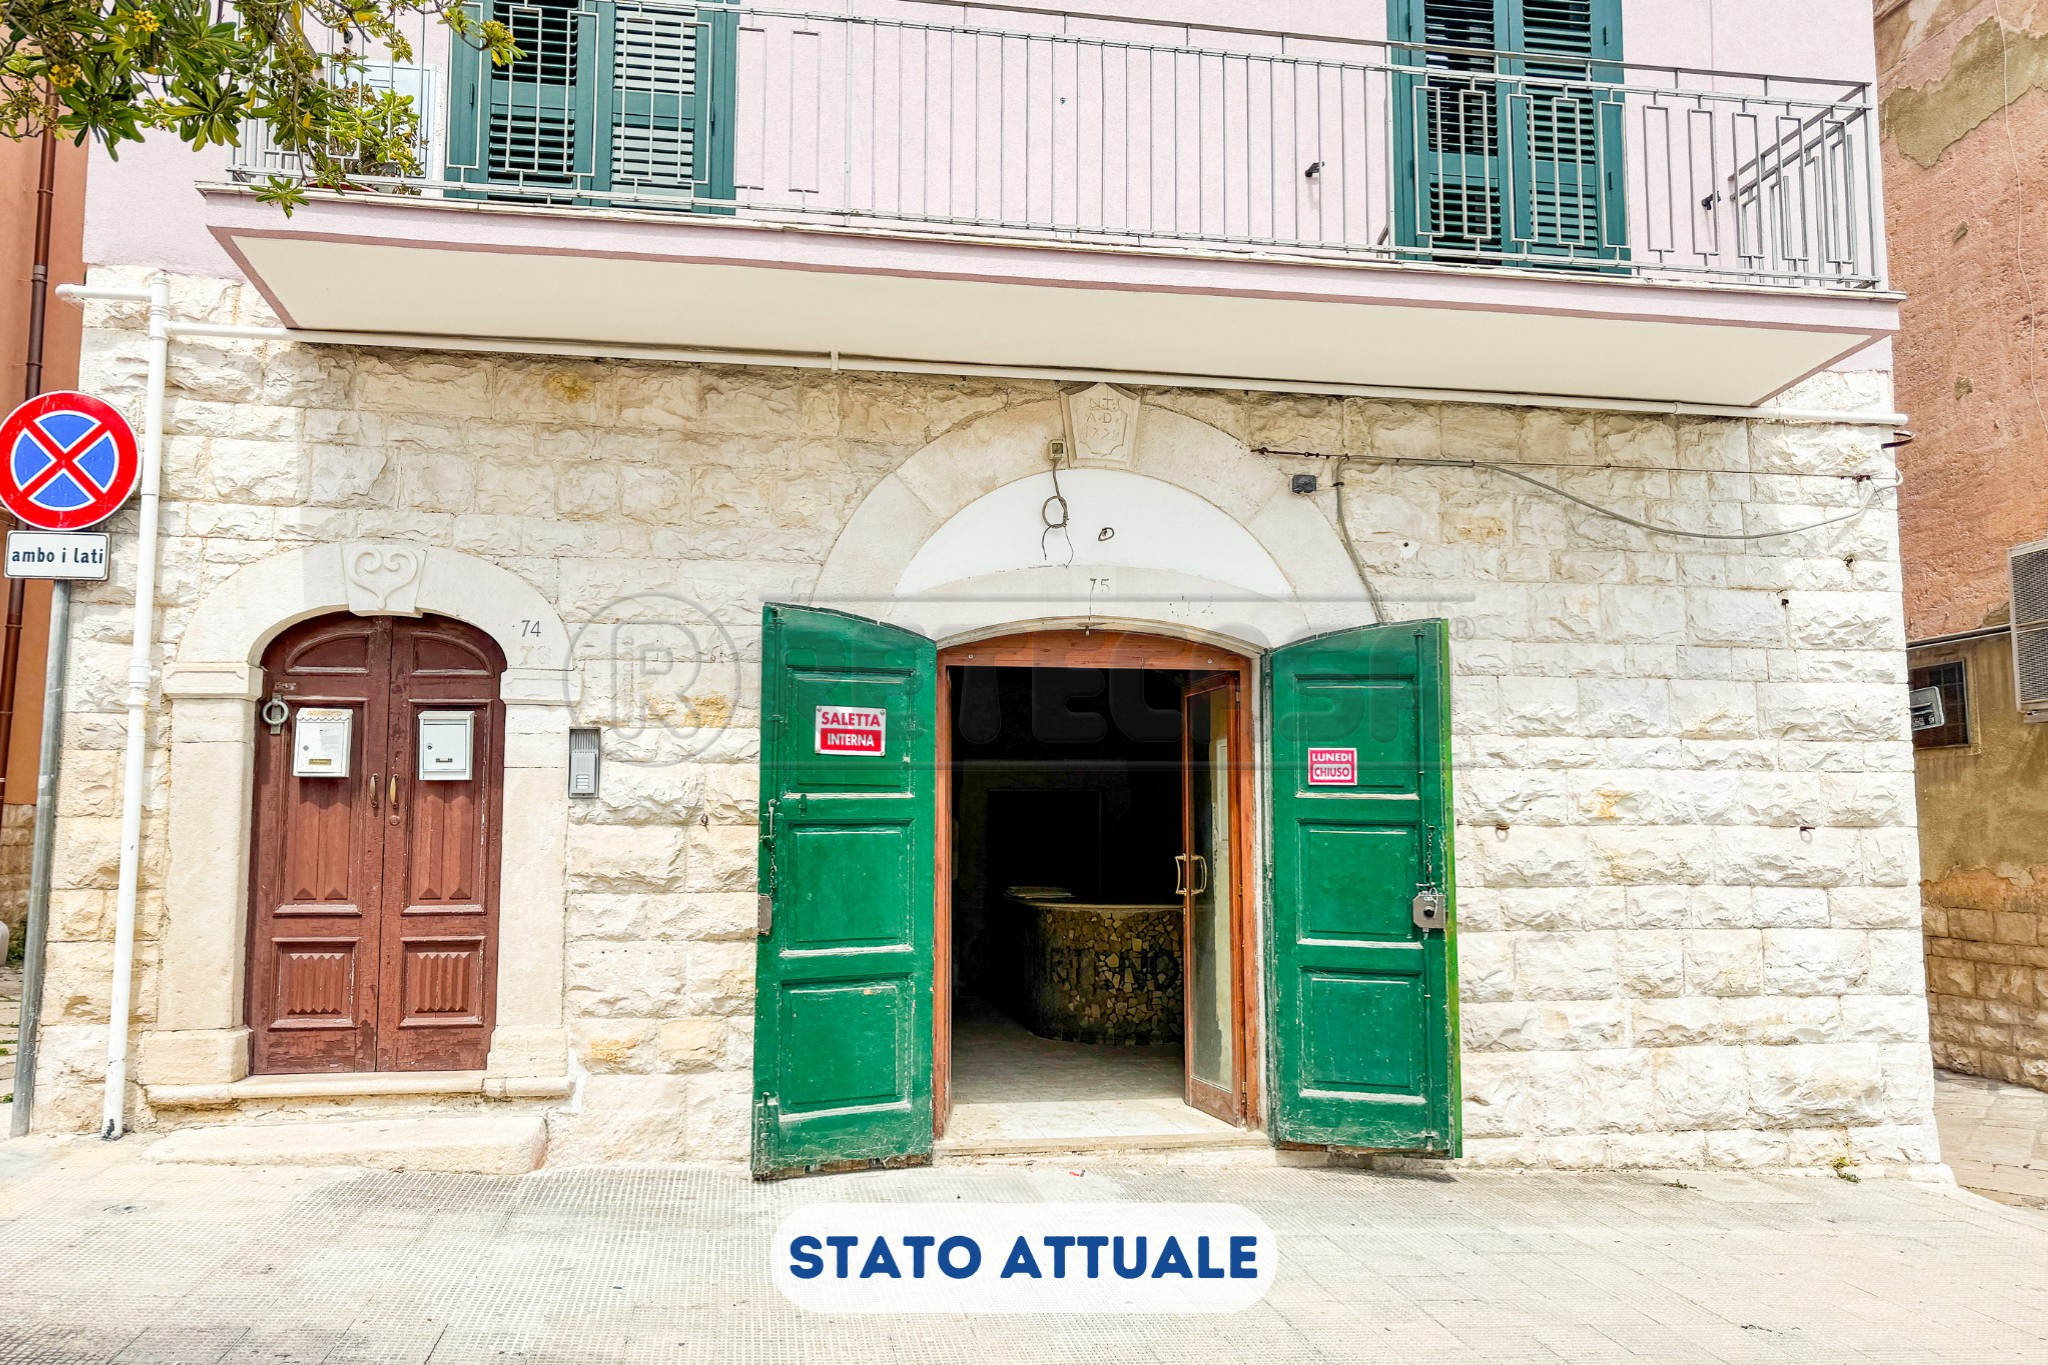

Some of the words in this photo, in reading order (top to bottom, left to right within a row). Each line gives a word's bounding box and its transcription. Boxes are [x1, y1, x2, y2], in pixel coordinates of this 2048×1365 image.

[12, 546, 55, 563] ambo
[61, 547, 67, 563] i
[73, 547, 104, 564] lati
[1089, 577, 1111, 593] 75
[521, 619, 542, 638] 74
[821, 711, 881, 728] SALETTA
[827, 732, 875, 747] INTERNA
[1311, 752, 1352, 762] LUNEDI
[1314, 766, 1350, 778] CHIUSO
